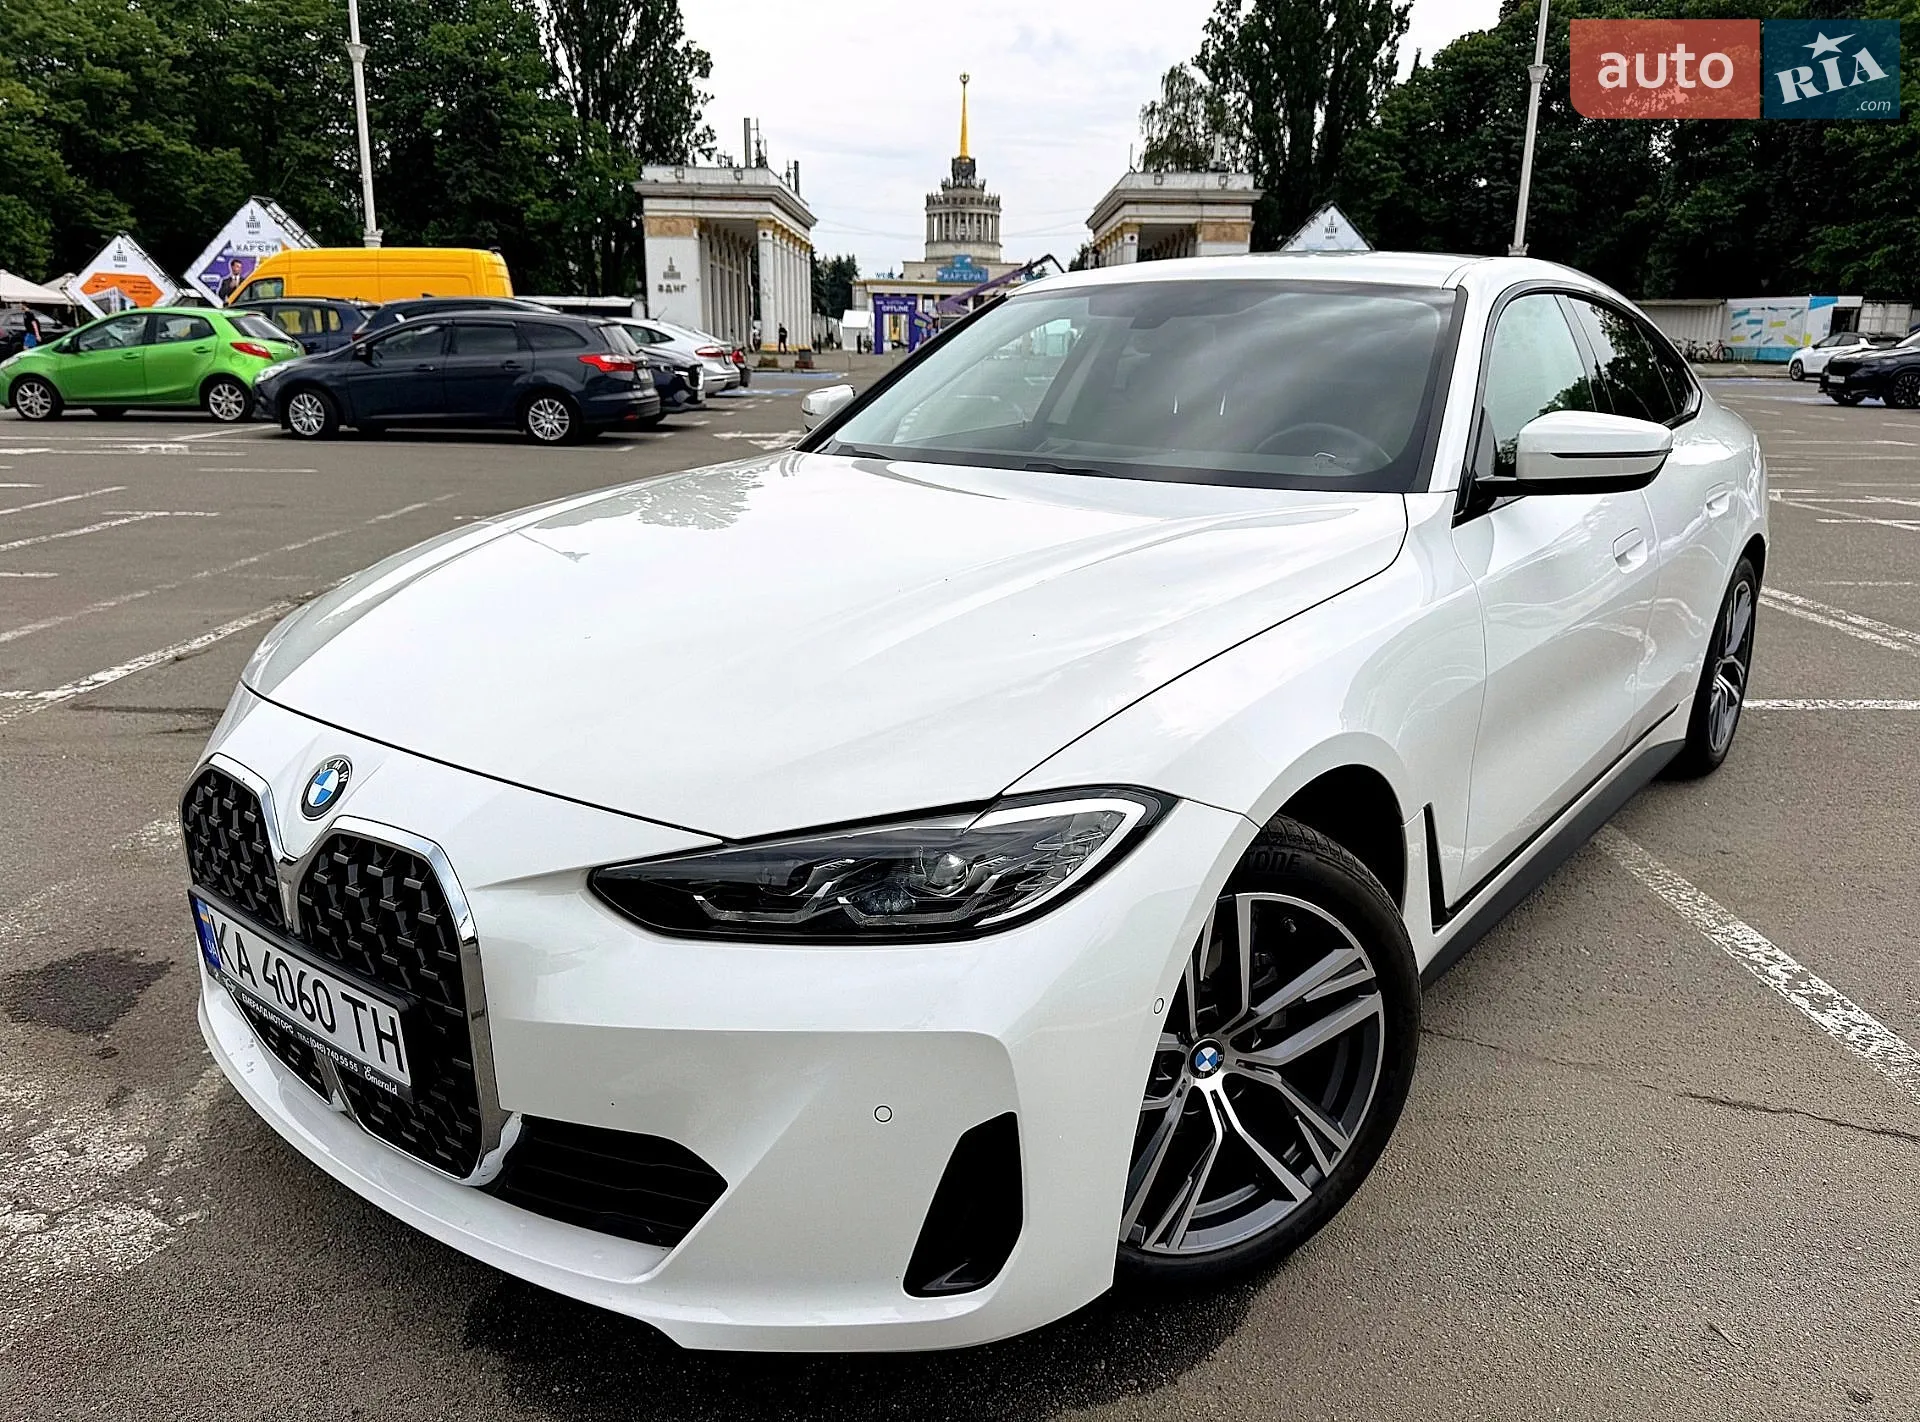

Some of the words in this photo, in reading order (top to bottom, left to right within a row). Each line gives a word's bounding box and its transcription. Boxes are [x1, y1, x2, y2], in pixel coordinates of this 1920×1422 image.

[262, 950, 337, 1034] 4060
[326, 1048, 339, 1062] 740
[339, 1055, 349, 1068] 55
[349, 1061, 359, 1072] 55
[363, 1065, 399, 1096] Emerald
